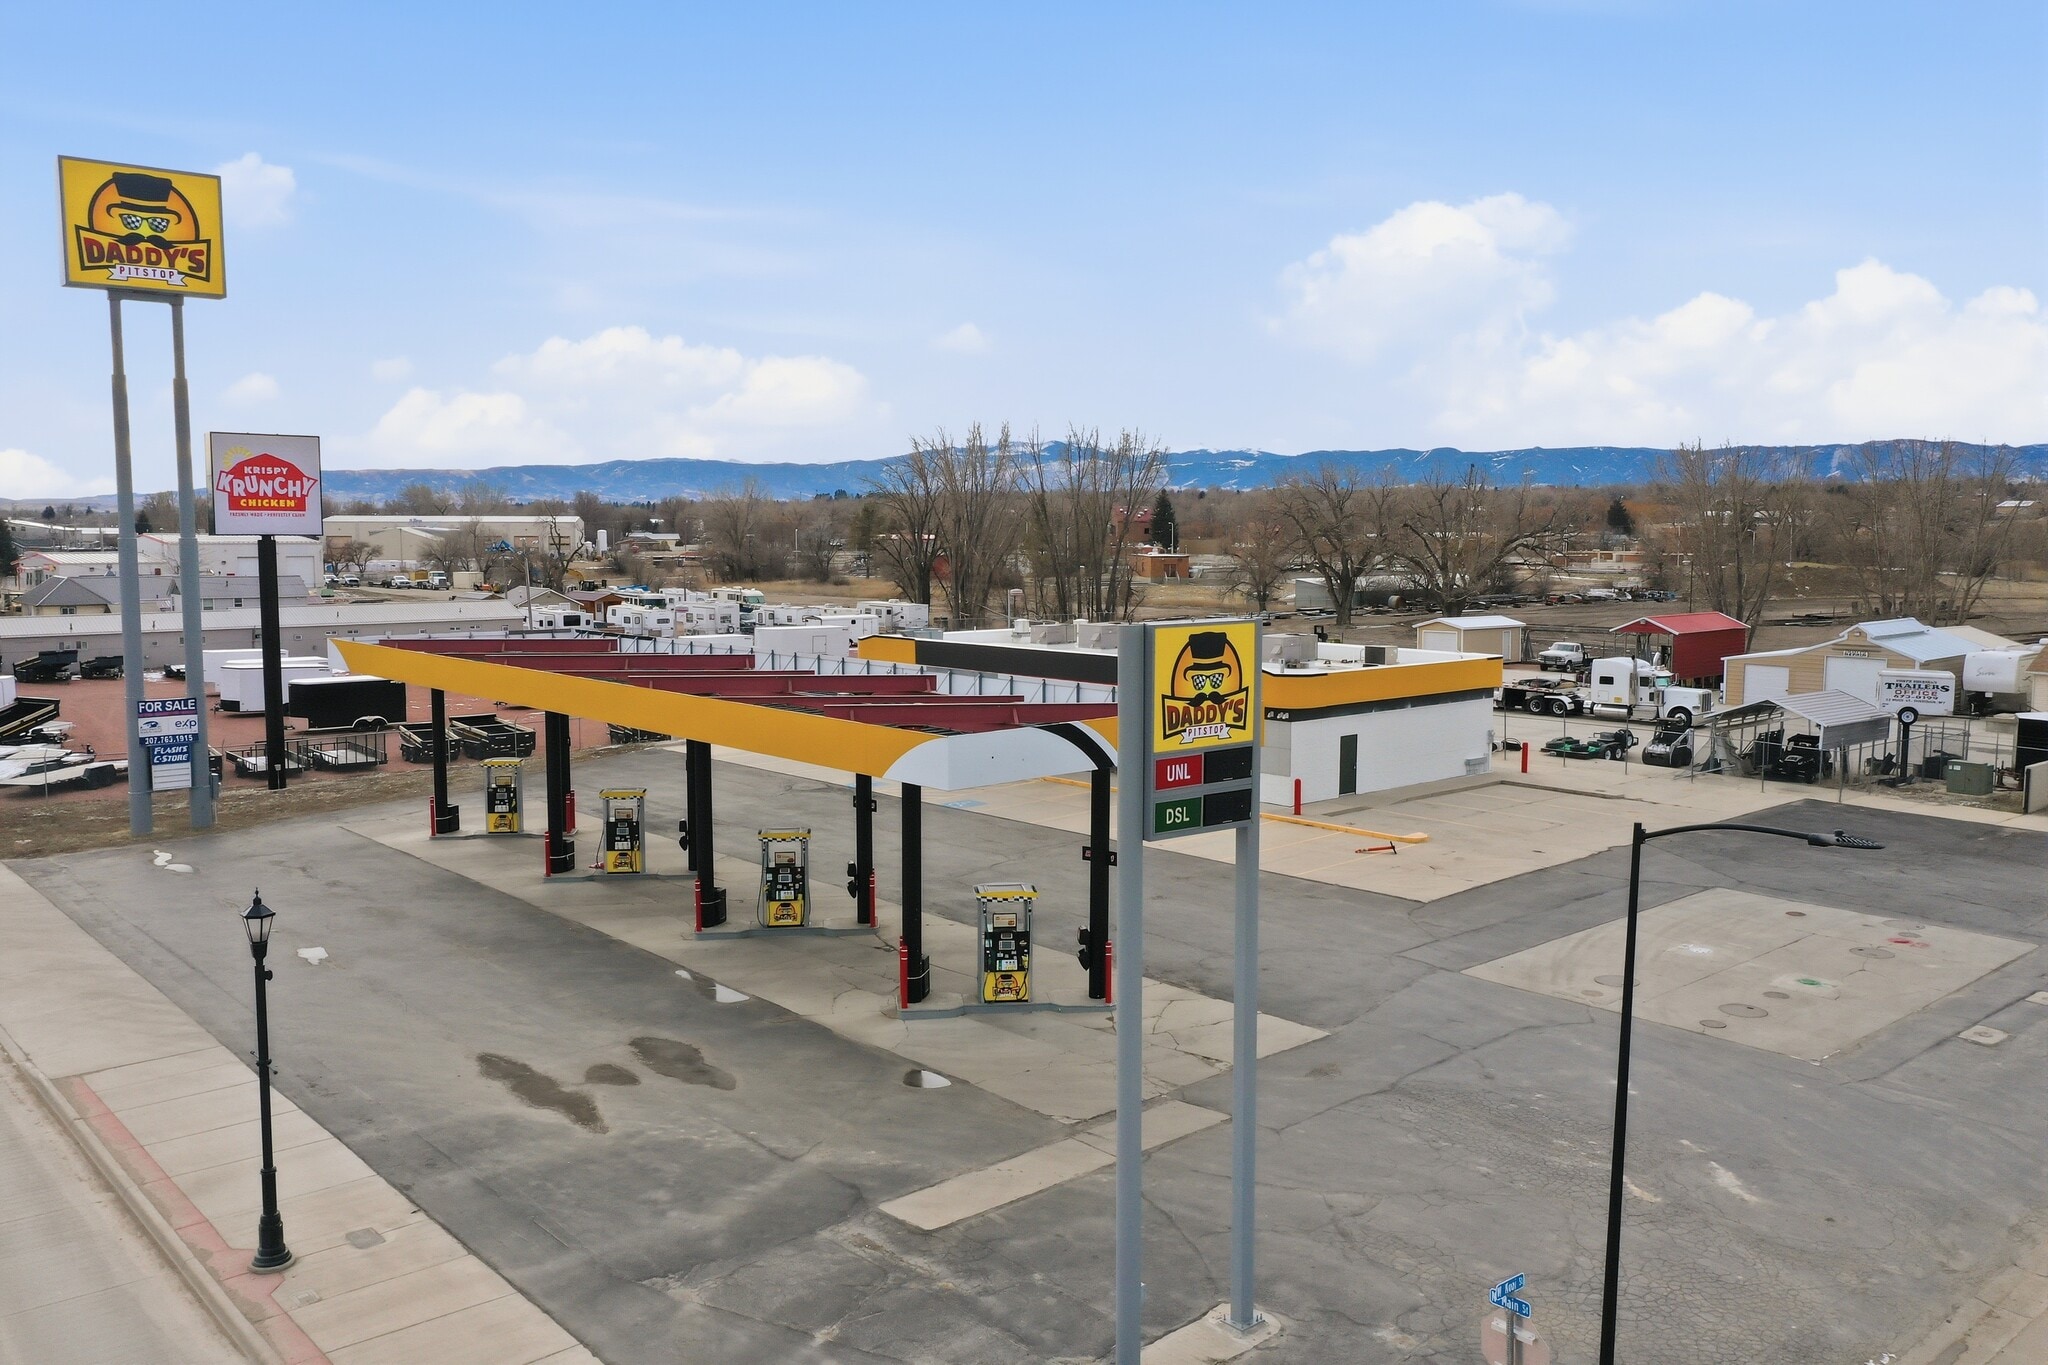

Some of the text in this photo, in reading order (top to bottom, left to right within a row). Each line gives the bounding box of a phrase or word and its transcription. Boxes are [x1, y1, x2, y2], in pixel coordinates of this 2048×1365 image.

[83, 236, 205, 274] DADDY'S
[119, 265, 175, 279] PITSTOP
[244, 466, 288, 475] KRISPY
[218, 472, 315, 498] KRUNCHY
[240, 499, 296, 507] CHICKEN
[1885, 682, 1950, 692] TRAILERS
[139, 700, 195, 712] FOR SALE
[1166, 698, 1245, 731] DADDY'S
[1187, 724, 1224, 737] PITSTOP
[1166, 762, 1191, 782] UNL
[1166, 806, 1190, 825] DSL
[1502, 1296, 1518, 1311] Main
